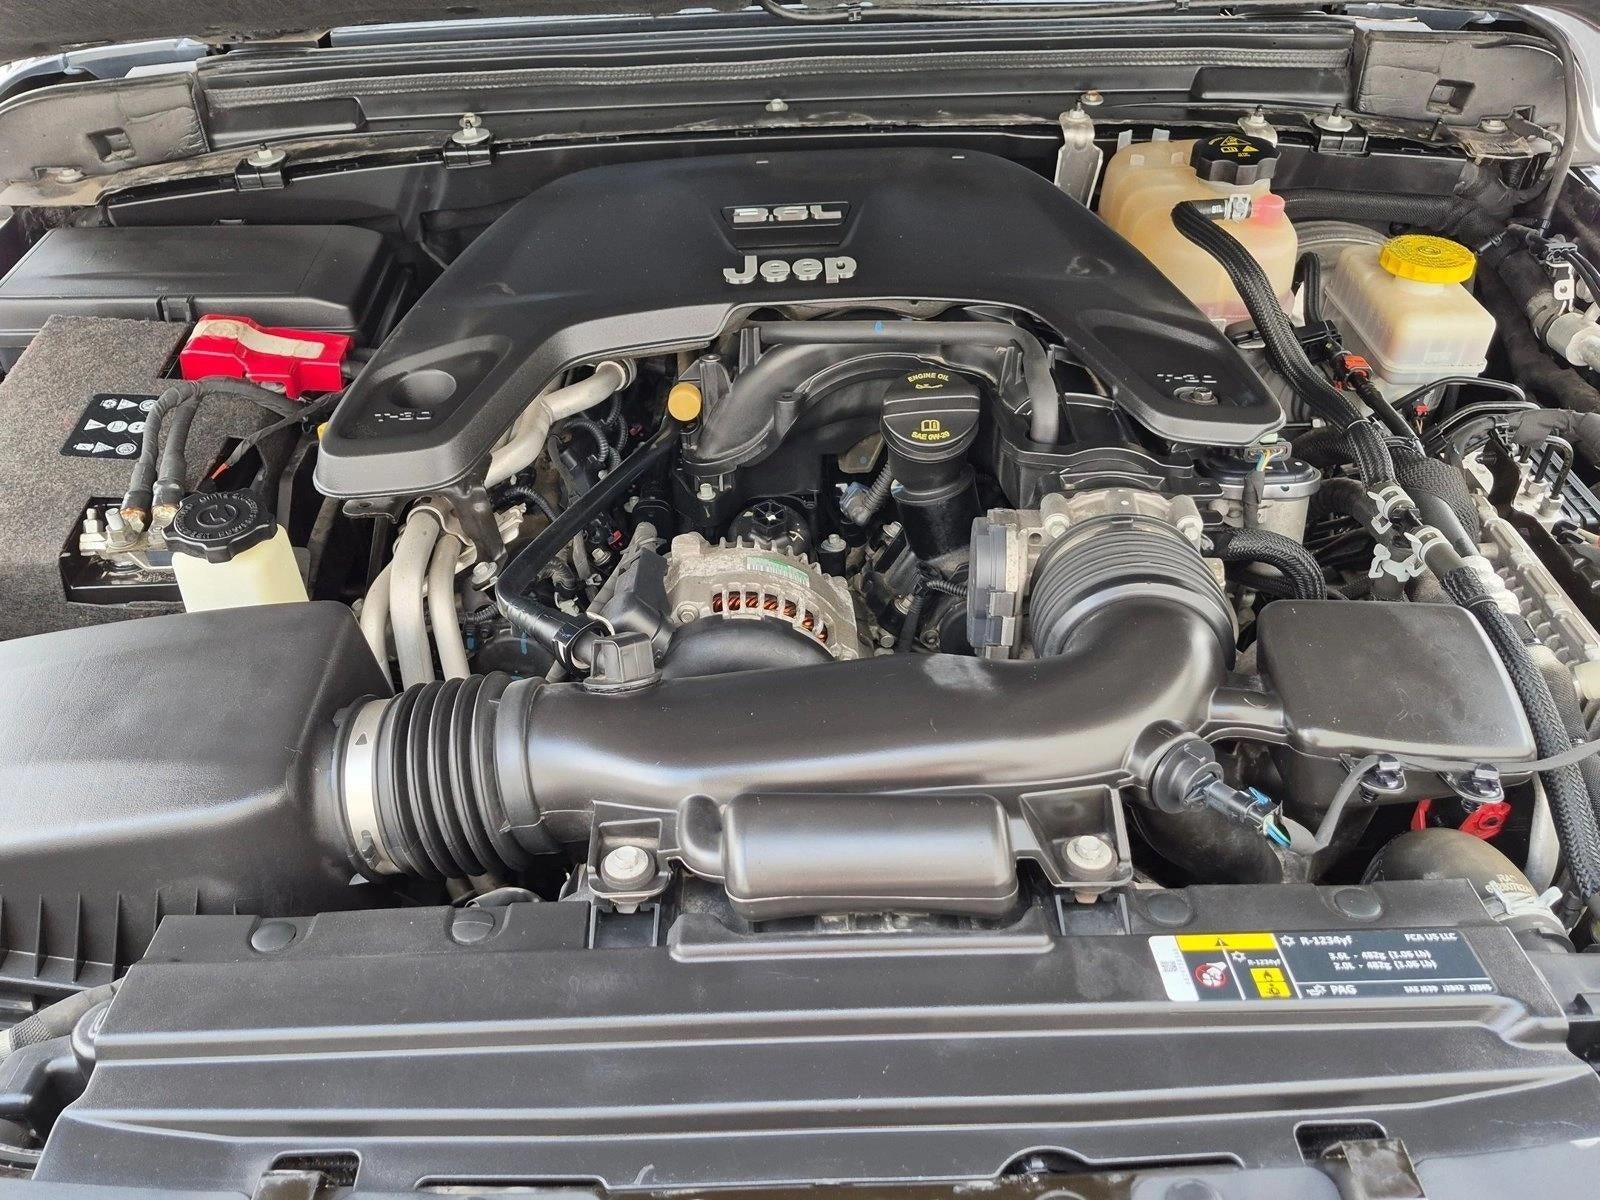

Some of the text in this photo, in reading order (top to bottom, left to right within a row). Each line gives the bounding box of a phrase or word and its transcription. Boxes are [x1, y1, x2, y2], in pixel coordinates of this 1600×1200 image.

[733, 204, 842, 223] 3.6L
[723, 255, 857, 285] Jeep
[907, 372, 949, 383] ENGINE OIL
[911, 430, 950, 441] SAE 0W-20
[1299, 935, 1352, 947] R-1234yf
[1404, 932, 1458, 942] FCA US LLC
[1330, 985, 1357, 995] PAG
